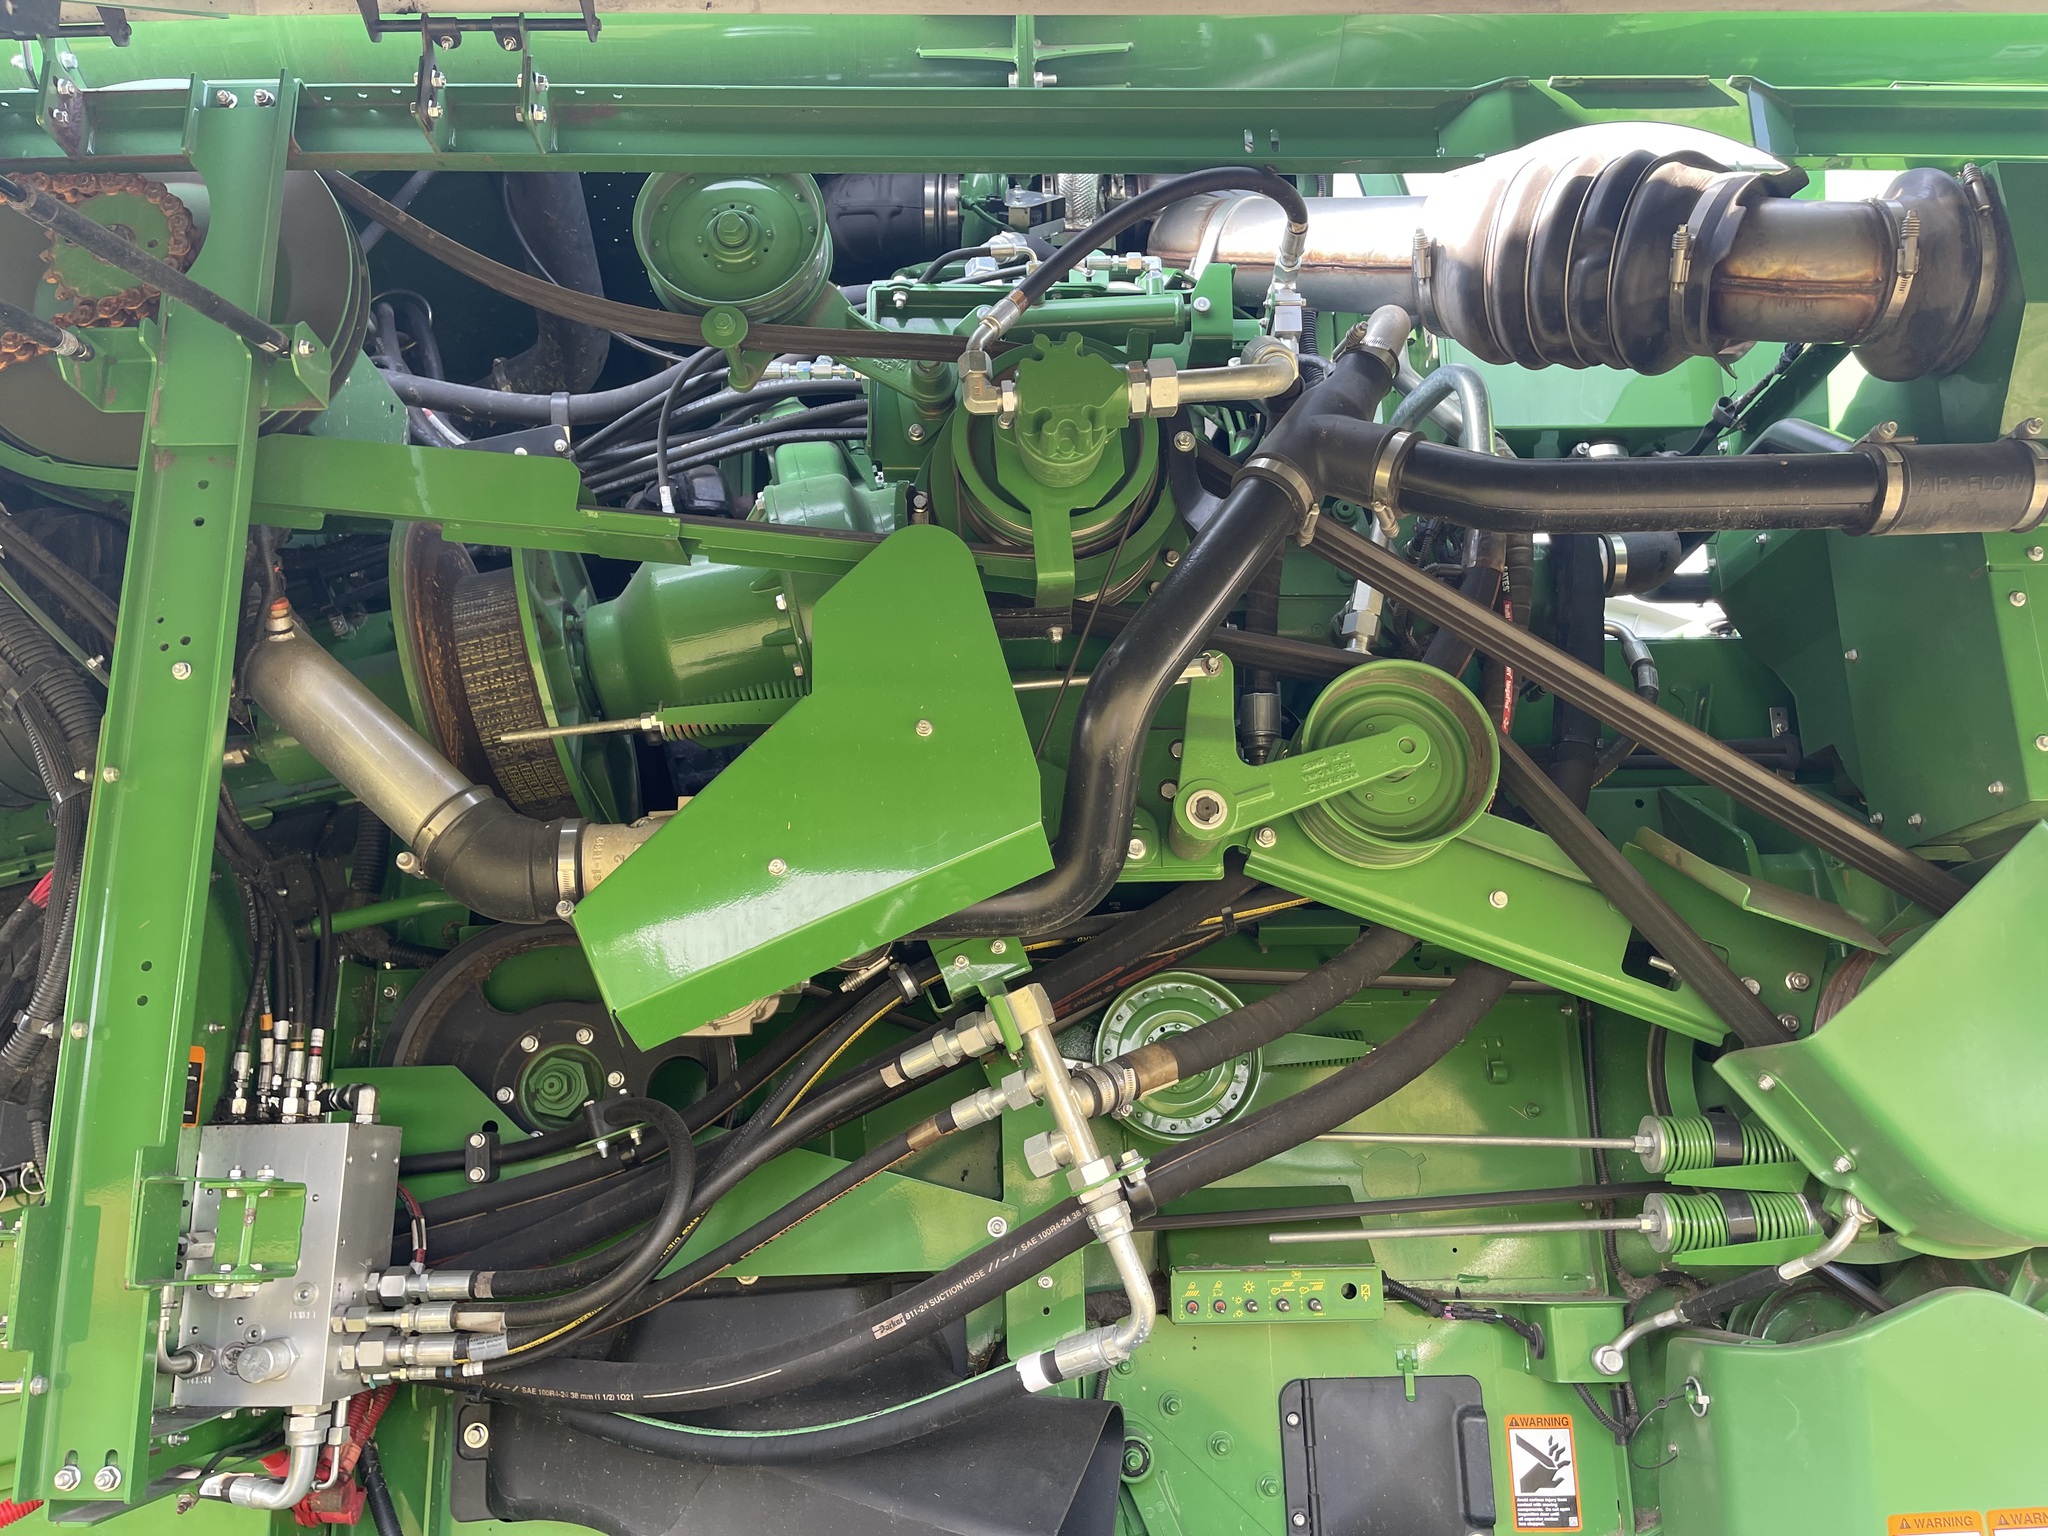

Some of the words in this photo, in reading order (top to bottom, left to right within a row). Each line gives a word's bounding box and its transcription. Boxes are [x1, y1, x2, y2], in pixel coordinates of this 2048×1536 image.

[1919, 476, 1951, 492] AIR
[1968, 475, 2026, 492] FLOW
[876, 1316, 905, 1333] Parker
[904, 1302, 929, 1321] 811-24
[929, 1282, 964, 1307] SUCTION
[963, 1268, 986, 1287] HOSE
[1020, 1236, 1038, 1251] SAE
[1038, 1215, 1072, 1240] 100R4-24
[1071, 1209, 1082, 1220] 38
[521, 1386, 537, 1395] SAE
[538, 1388, 569, 1398] 100R4-24
[616, 1393, 635, 1401] 1Q21
[1519, 1416, 1569, 1427] WARNING
[1913, 1515, 1974, 1529] WARNING
